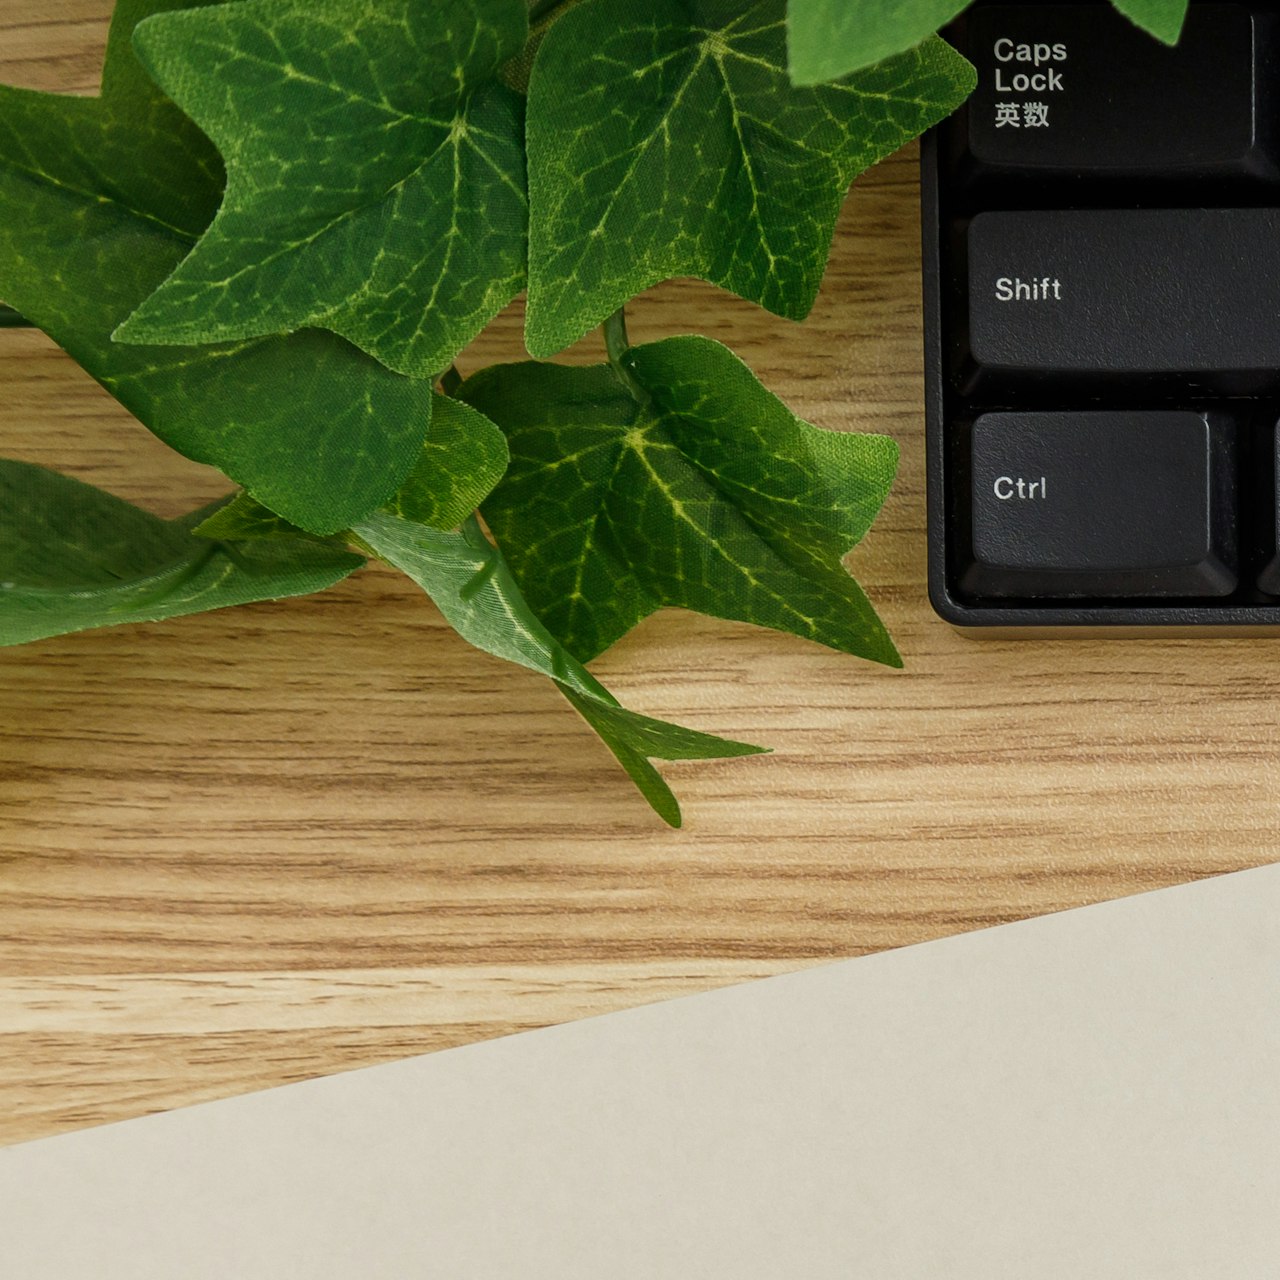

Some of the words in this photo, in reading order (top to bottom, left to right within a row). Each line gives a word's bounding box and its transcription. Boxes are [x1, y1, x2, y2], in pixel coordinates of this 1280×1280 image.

[993, 38, 1068, 67] Caps
[995, 67, 1064, 92] Lock
[994, 101, 1050, 128] 英数
[995, 277, 1061, 301] Shift
[993, 476, 1046, 500] Ctrl
